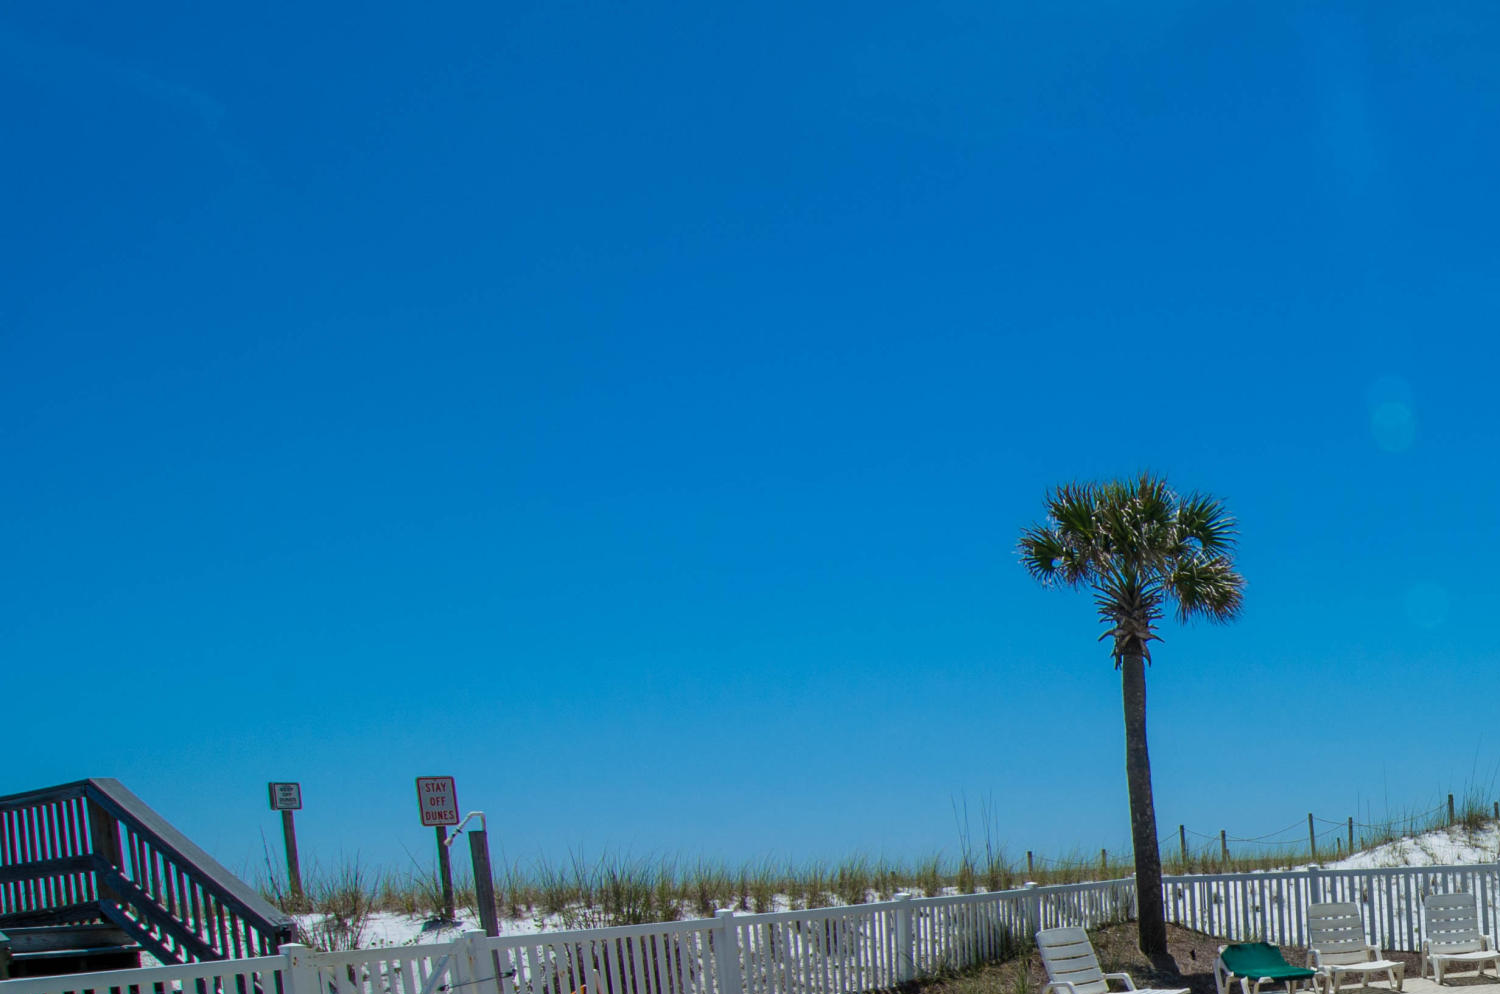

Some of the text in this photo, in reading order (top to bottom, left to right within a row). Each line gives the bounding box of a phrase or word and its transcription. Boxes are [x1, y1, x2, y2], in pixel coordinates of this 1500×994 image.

[425, 782, 447, 793] STAY
[430, 796, 446, 806] OFF
[425, 810, 455, 821] DUNES
